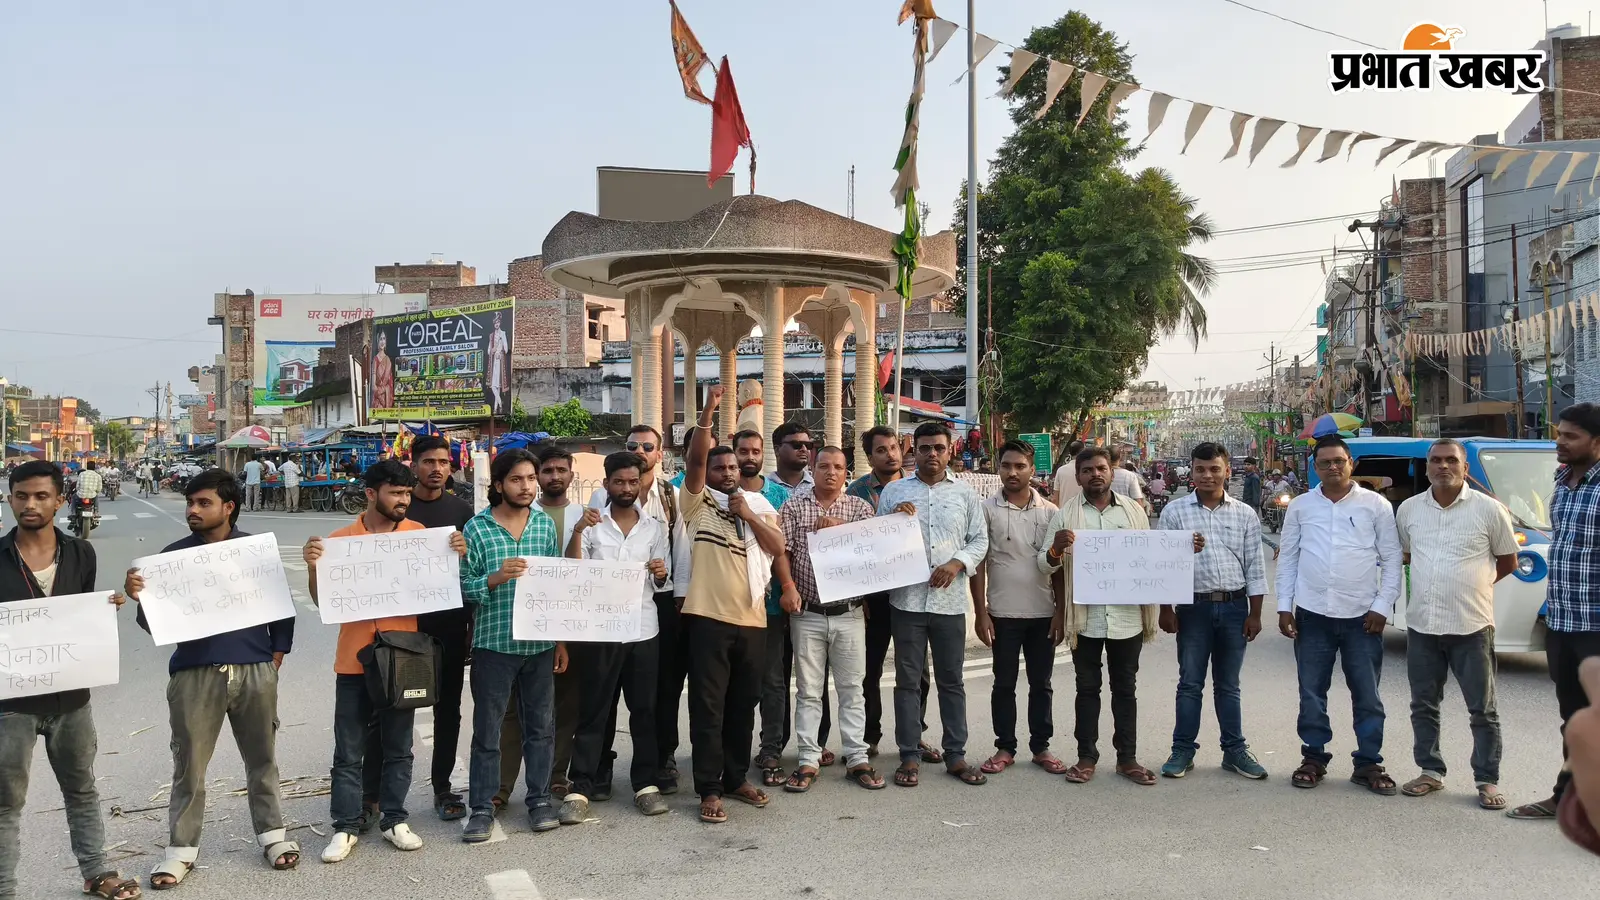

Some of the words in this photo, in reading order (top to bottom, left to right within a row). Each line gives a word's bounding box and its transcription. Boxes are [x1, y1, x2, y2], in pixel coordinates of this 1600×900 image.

[477, 302, 497, 310] BEAUTY
[498, 299, 512, 307] ZONE
[308, 309, 321, 320] घर
[324, 307, 339, 320] को
[341, 307, 362, 320] पानी
[363, 307, 375, 319] से
[403, 346, 435, 354] PROFESSIONAL
[346, 541, 363, 558] 17
[330, 559, 384, 585] काला
[588, 565, 607, 579] का
